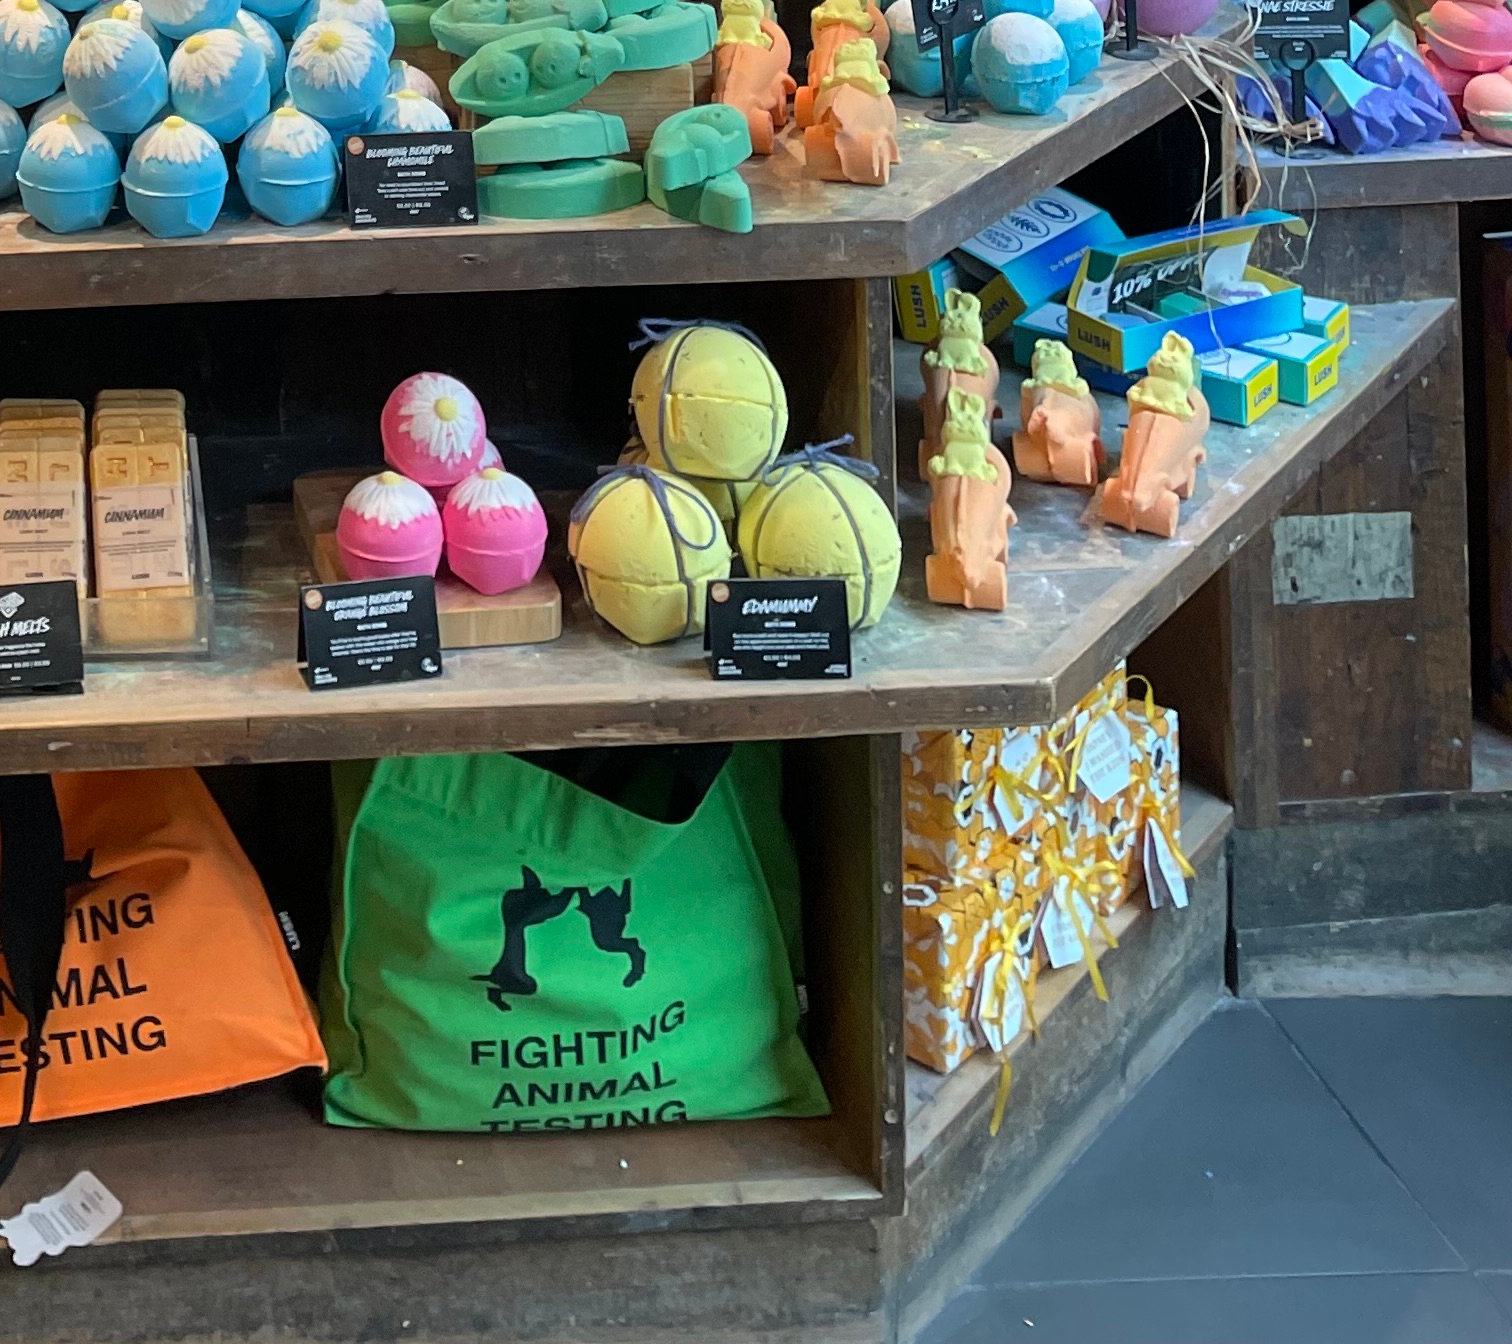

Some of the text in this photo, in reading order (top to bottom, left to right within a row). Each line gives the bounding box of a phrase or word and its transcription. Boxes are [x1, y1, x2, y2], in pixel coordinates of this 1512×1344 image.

[1112, 275, 1153, 304] 10%
[911, 283, 927, 329] LUSH
[988, 296, 1010, 322] USH
[1077, 326, 1112, 352] LUSH
[742, 595, 818, 615] EDAMUMMY
[9, 616, 51, 637] MELTS
[470, 1000, 687, 1070] FIGHTING
[491, 1061, 678, 1110] ANIMAL
